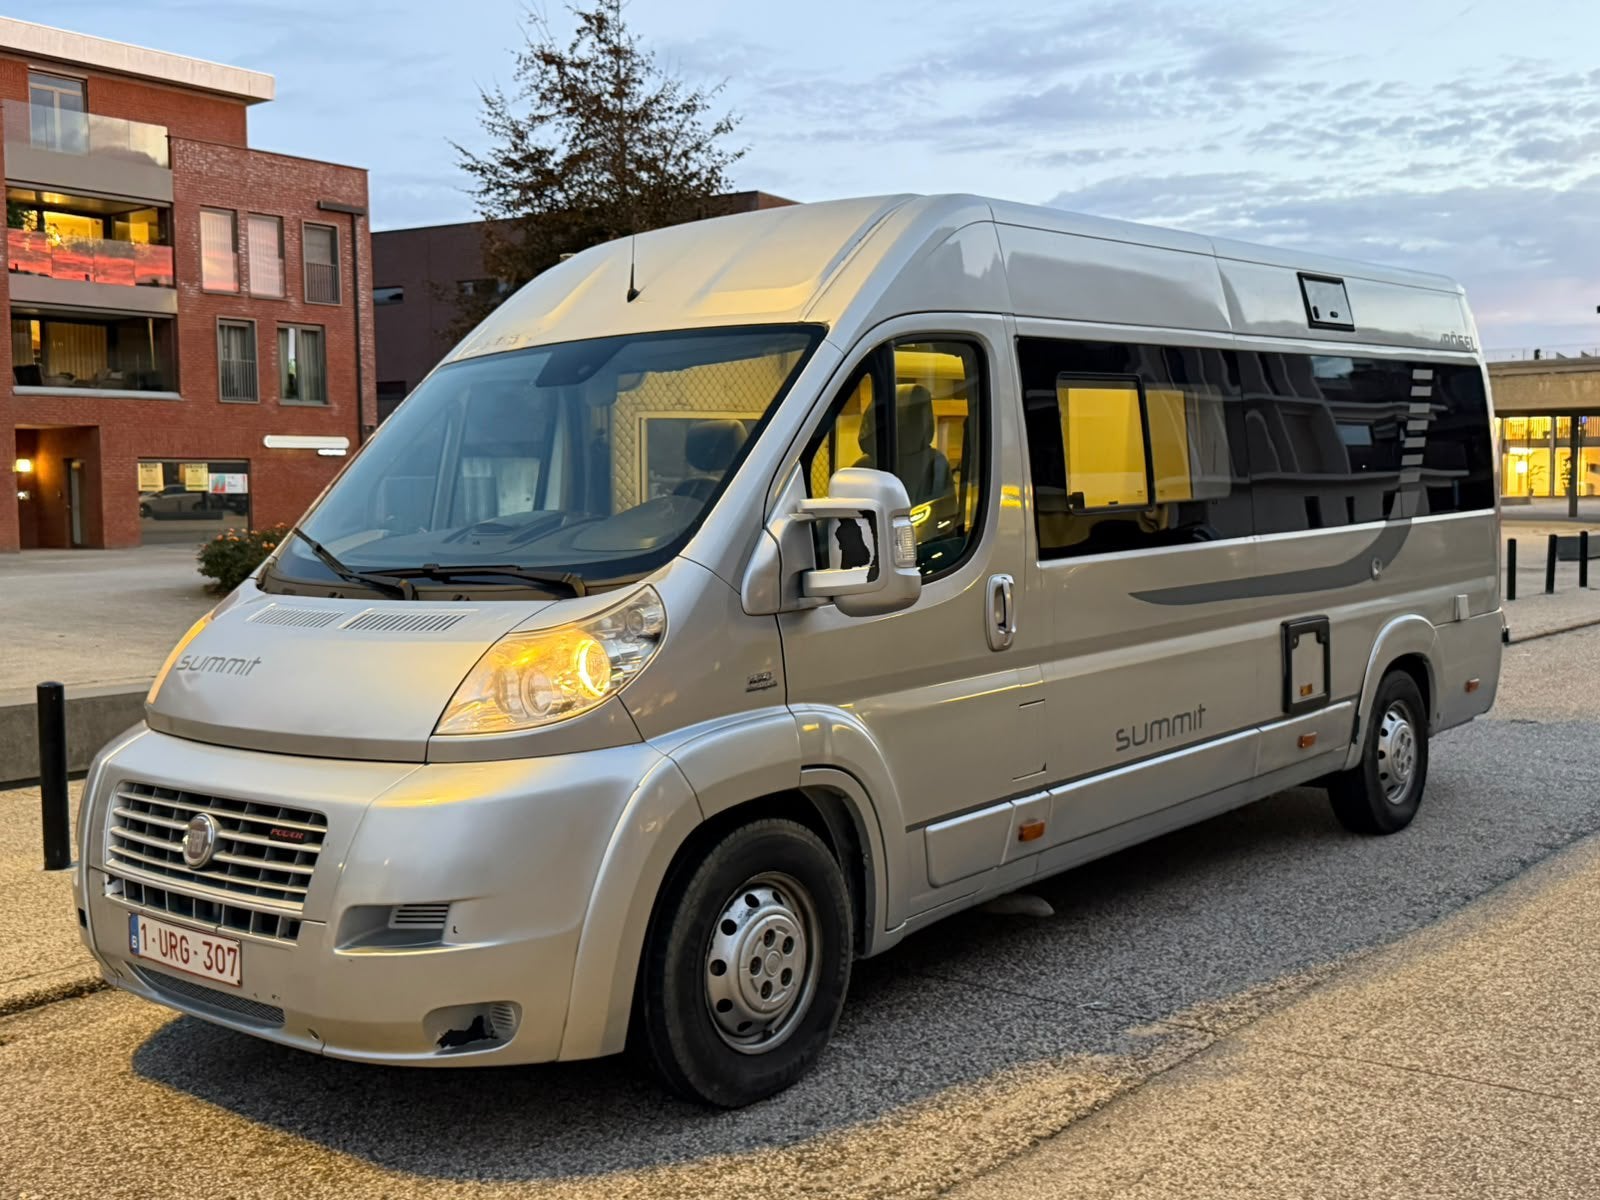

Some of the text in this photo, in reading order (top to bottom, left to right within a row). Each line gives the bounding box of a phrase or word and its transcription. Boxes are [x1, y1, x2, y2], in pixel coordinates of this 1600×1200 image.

[176, 655, 261, 676] summit
[1116, 704, 1206, 752] summit
[141, 923, 237, 976] 1-URG-307
